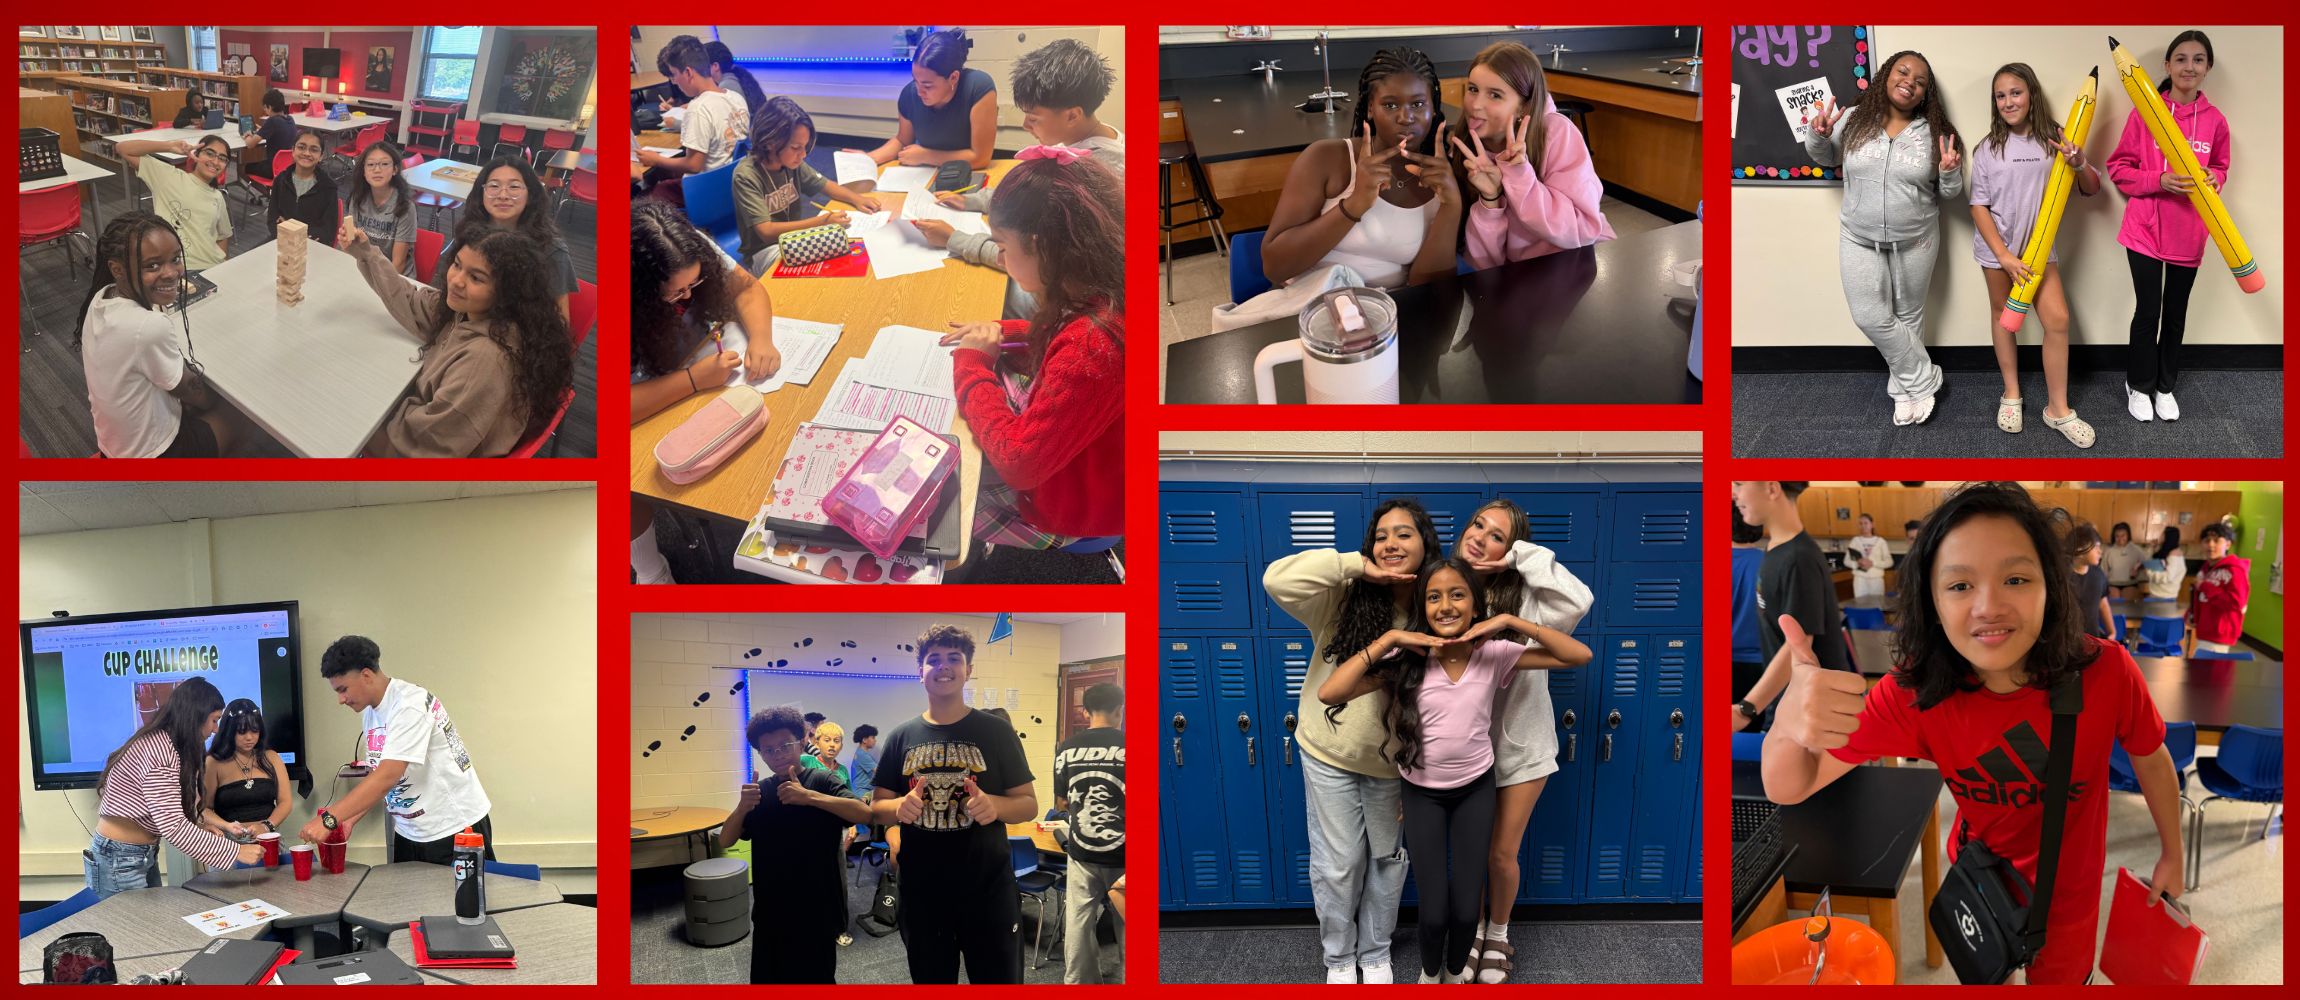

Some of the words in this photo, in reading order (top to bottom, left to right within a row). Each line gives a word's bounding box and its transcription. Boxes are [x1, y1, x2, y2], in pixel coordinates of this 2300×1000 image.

[1731, 25, 1832, 68] ay?
[902, 742, 988, 776] CHICAGO
[1945, 777, 2088, 809] adids
